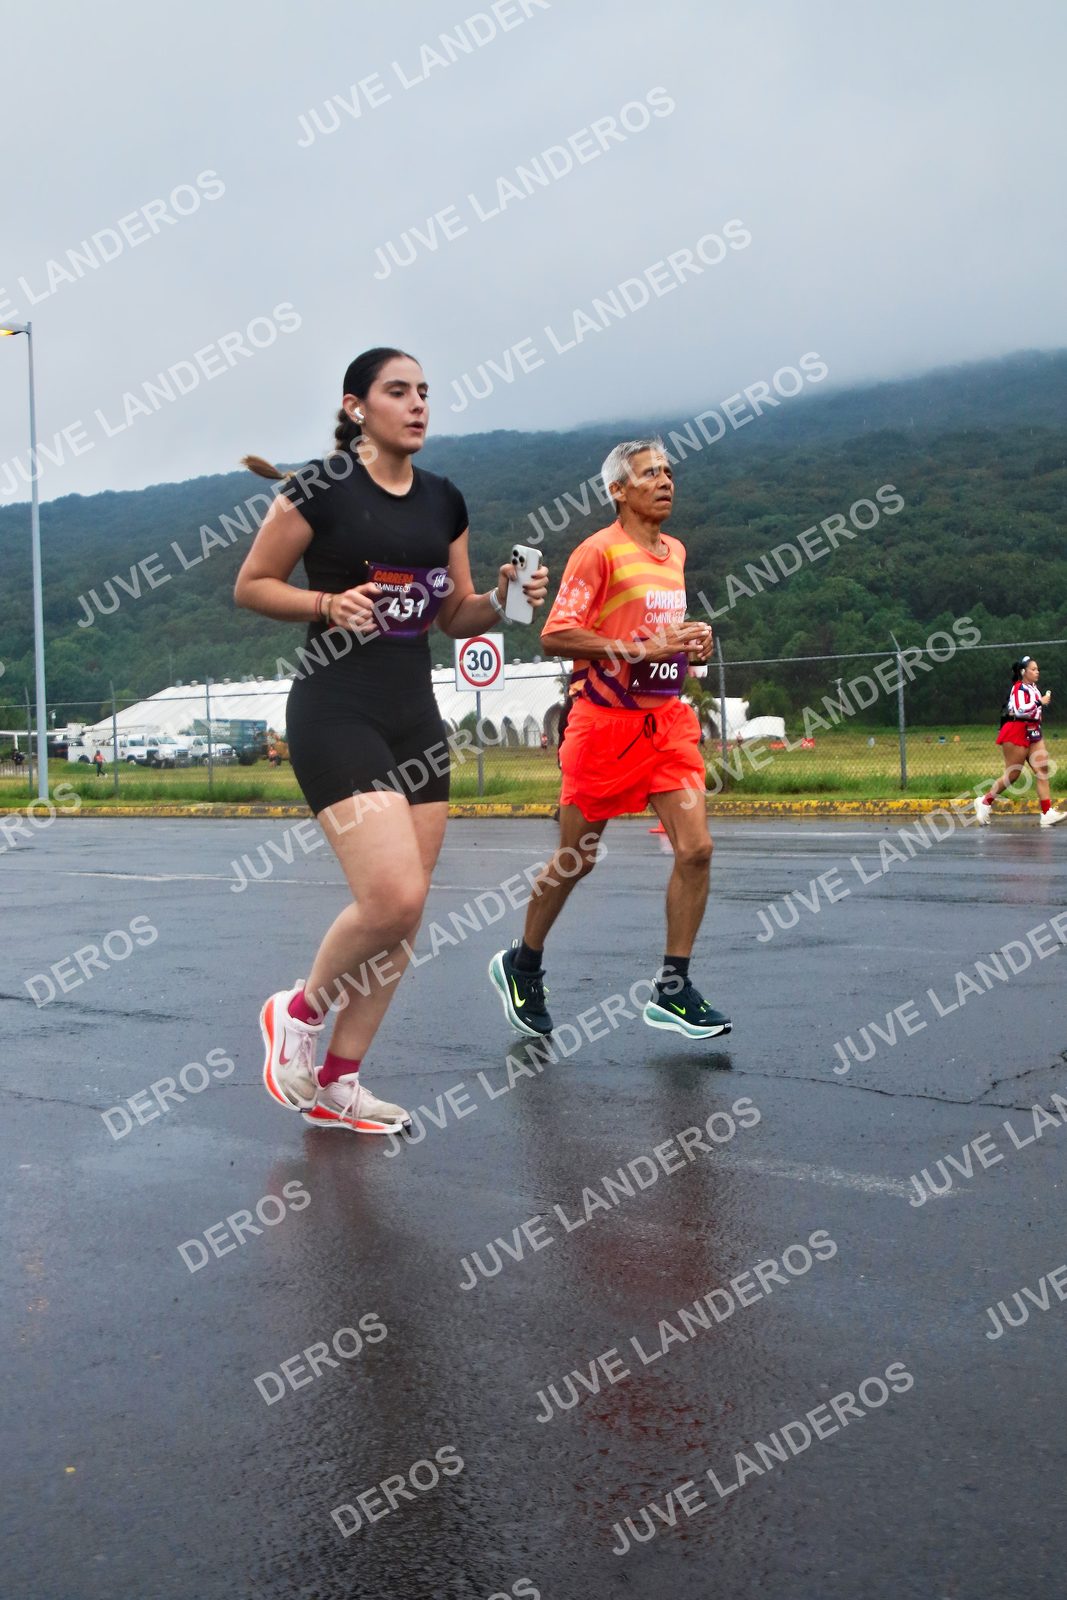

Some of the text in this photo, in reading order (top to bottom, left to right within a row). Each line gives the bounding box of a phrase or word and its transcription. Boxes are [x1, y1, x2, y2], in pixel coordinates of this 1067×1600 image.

[387, 597, 425, 618] 431
[466, 649, 493, 671] 30
[649, 662, 678, 679] 706
